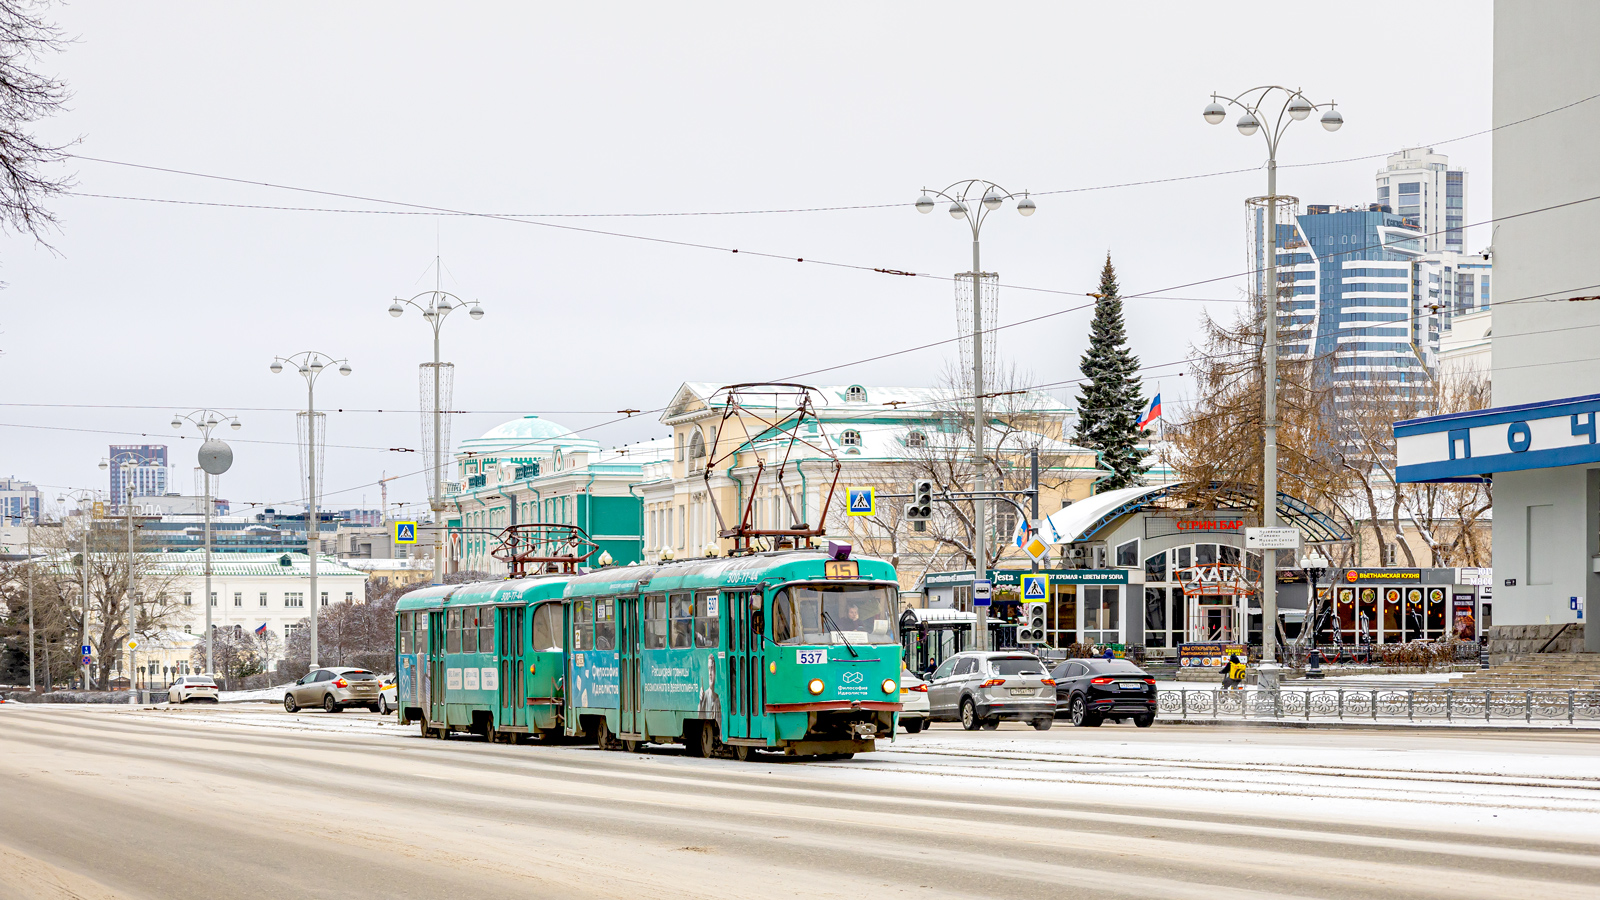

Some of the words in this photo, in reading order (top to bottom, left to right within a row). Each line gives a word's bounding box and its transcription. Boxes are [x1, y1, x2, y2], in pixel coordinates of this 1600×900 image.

[110, 504, 162, 516] ЕВОПА
[1176, 520, 1217, 530] СТРИМ
[1219, 520, 1244, 530] БАР
[832, 564, 851, 577] 15
[1193, 566, 1243, 582] ХАТА
[727, 571, 759, 583] 300-77-44
[800, 653, 822, 664] 537
